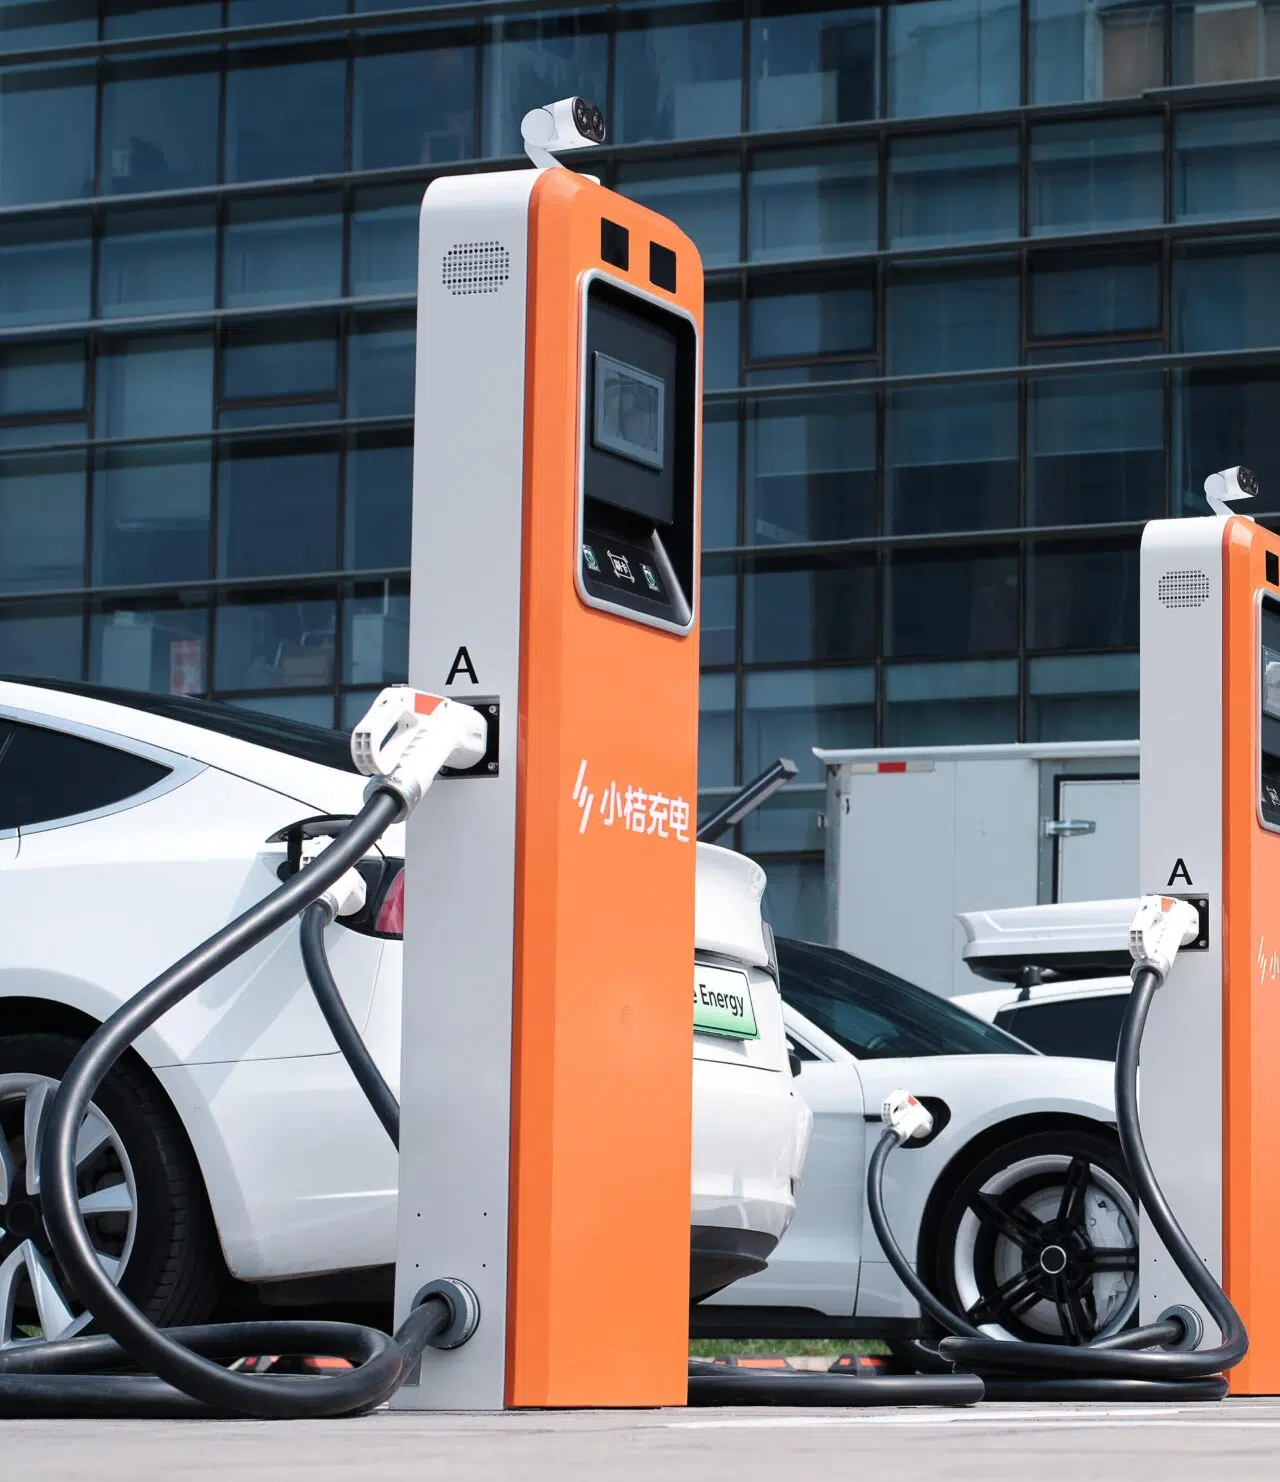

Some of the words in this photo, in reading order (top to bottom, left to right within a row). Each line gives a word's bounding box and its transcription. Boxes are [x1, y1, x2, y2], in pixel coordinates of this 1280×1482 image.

[445, 646, 479, 686] A
[600, 781, 690, 843] 小桔充电
[1167, 858, 1193, 886] A
[699, 983, 744, 1018] Energy
